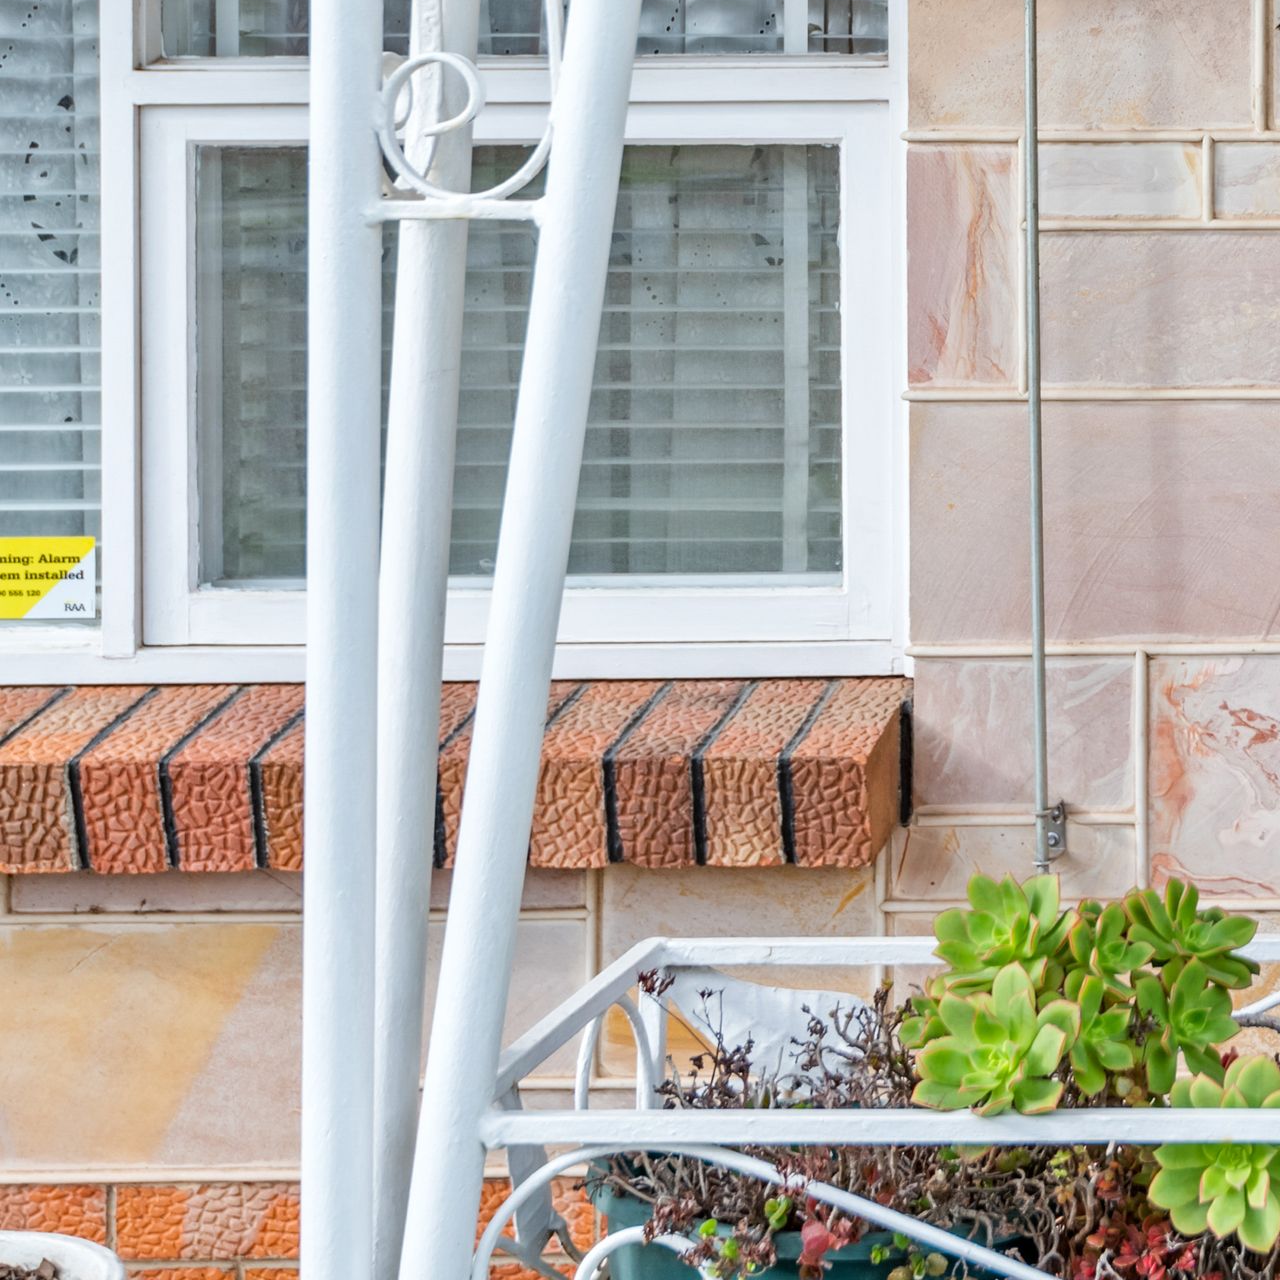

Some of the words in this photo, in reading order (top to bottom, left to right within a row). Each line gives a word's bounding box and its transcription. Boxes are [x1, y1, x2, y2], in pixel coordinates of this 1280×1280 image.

[38, 554, 80, 564] Alarm
[0, 572, 20, 580] em
[25, 570, 84, 580] installed
[64, 603, 86, 612] RAA
